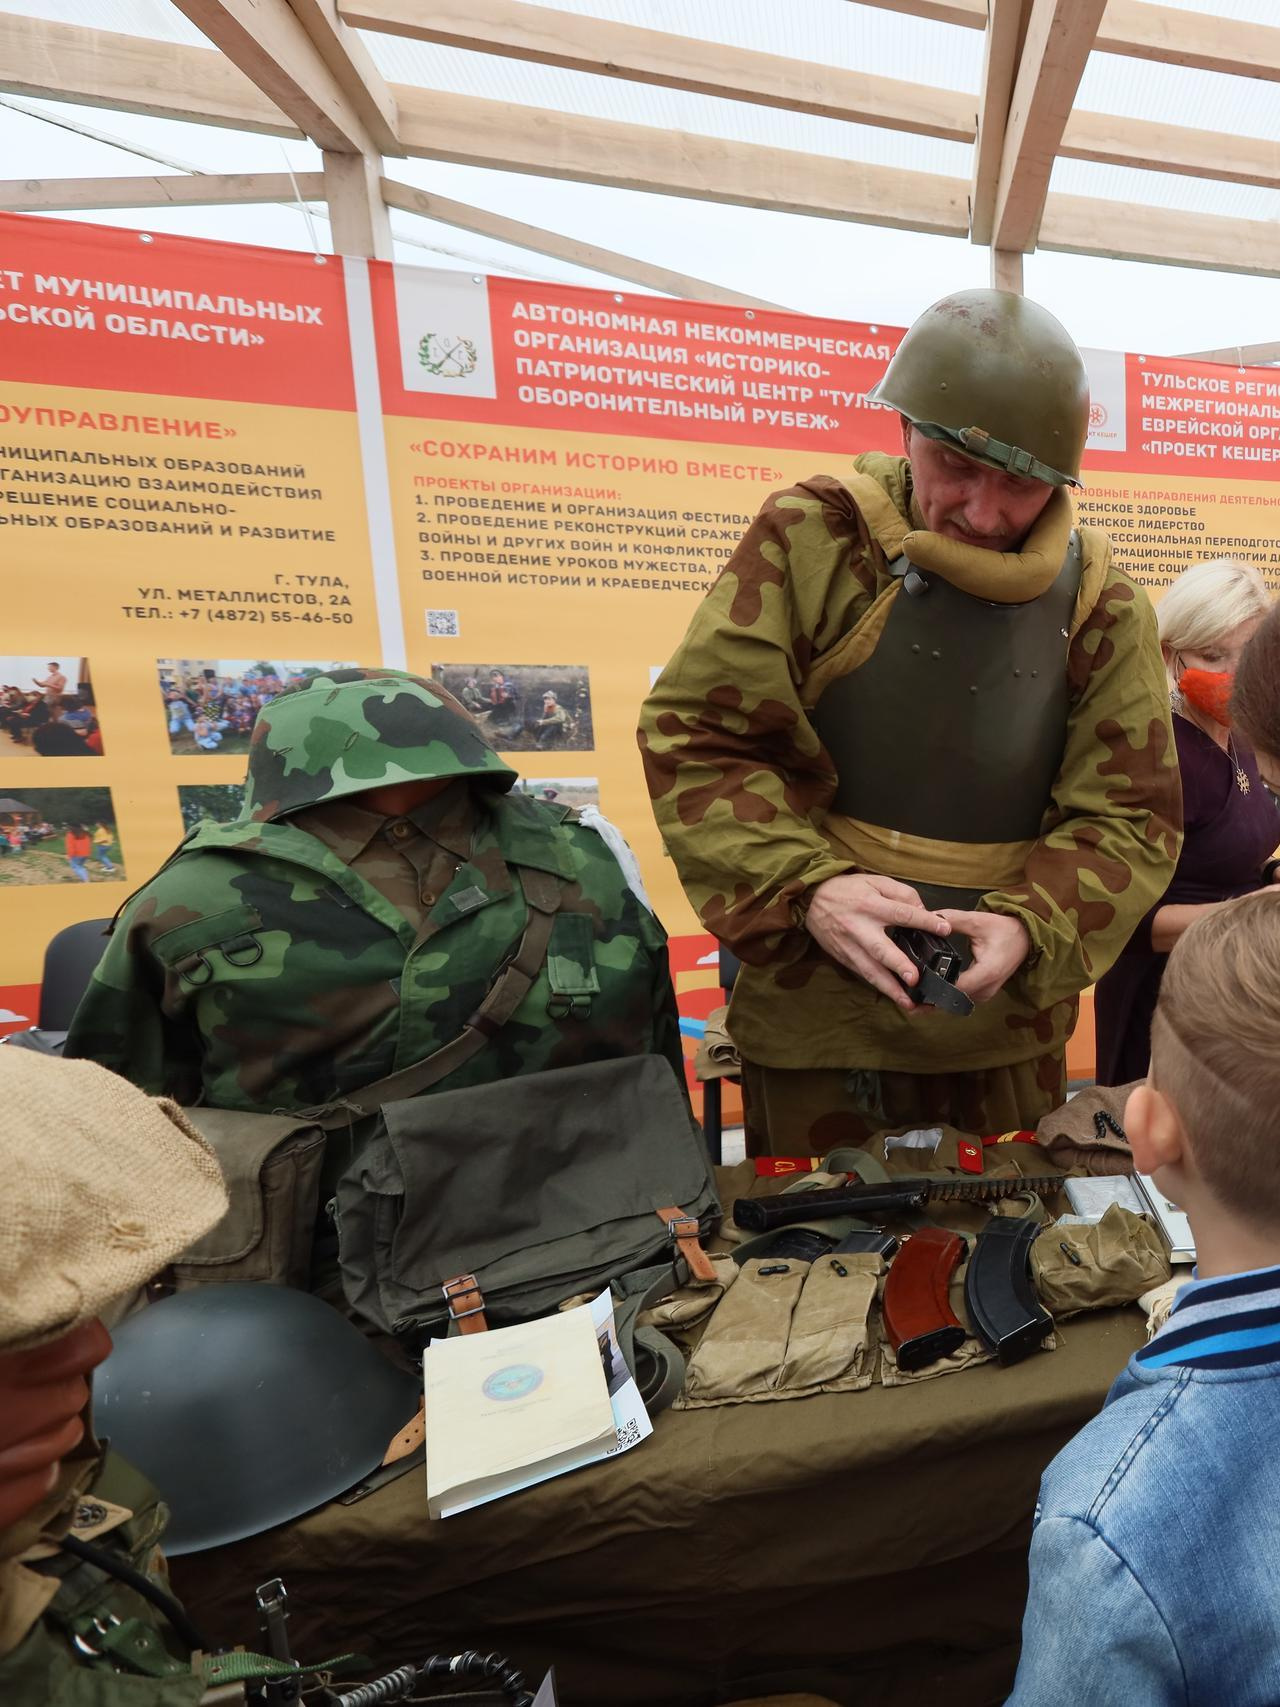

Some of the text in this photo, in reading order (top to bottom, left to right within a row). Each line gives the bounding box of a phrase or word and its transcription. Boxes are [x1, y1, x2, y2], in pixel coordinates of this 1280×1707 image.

[34, 274, 324, 326] МУНИЦИПАЛЬНЫХ
[105, 314, 263, 345] ОБЛАСТИ»
[512, 303, 892, 364] АВТОНОМНАЯ НЕКОММЕРЧЕСКАЯ
[514, 330, 829, 378] ОРГАНИЗАЦИЯ «ИСТОРИКО-
[516, 357, 736, 396] ПАТРИОТИЧЕСКИЙ
[742, 381, 813, 403] ЦЕНТР
[1141, 372, 1229, 392] ТУЛЬСКОЕ
[518, 386, 839, 429] ОБОРОНИТЕЛЬНЫЙ РУБЕЖ»
[1142, 417, 1243, 437] ЕВРЕЙСКОЙ
[1142, 440, 1217, 457] «ПРОЕКТ
[163, 458, 304, 477] ОБРАЗОВАНИЙ
[410, 440, 782, 481] «СОХРАНИМ ИСТОРИЮ ВМЕСТЕ»
[0, 468, 321, 499] ГАНИЗАЦИЮ ВЗАИМОДЕЙСТВИЯ
[413, 476, 495, 491] ПРОЕКТЫ
[105, 497, 235, 515] СОЦИАЛЬНО-
[1133, 490, 1216, 502] НАПРАВЛЕНИЯ
[434, 495, 545, 512] ПРОВЕДЕНИЕ
[551, 502, 562, 513] И
[567, 504, 677, 520] ОРГАНИЗАЦИЯ
[682, 512, 751, 527] ФЕСТИВА
[1077, 502, 1196, 516] ЖЕНСКОЕ ЗДОРОВЬЕ
[65, 517, 213, 534] ОБРАЗОВАНИЙ
[220, 525, 232, 536] И
[239, 526, 335, 541] РАЗВИТИЕ
[436, 513, 548, 529] ПРОВЕДЕНИЕ
[554, 520, 686, 537] РЕКОНСТРУКЦИЙ
[690, 527, 744, 541] СРАЖЕ
[1078, 517, 1205, 531] ЖЕНСКОЕ ЛИДЕРСТВО
[418, 531, 733, 559] ВОЙНЫ И ДРУГИХ ВОЙН И КОНФЛИКТОВ
[440, 551, 551, 566] ПРОВЕДЕНИЕ
[556, 556, 618, 569] УРОКОВ
[274, 574, 349, 588] Г. ТУЛА,
[422, 569, 715, 592] ВОЕННОЙ ИСТОРИИ И КРАЕВЕДЧЕСК
[138, 587, 351, 606] УЛ. МЕТАЛЛИСТОВ, 2А
[121, 606, 353, 624] ТЕЛ.: +7 (4872) 55-46-50
